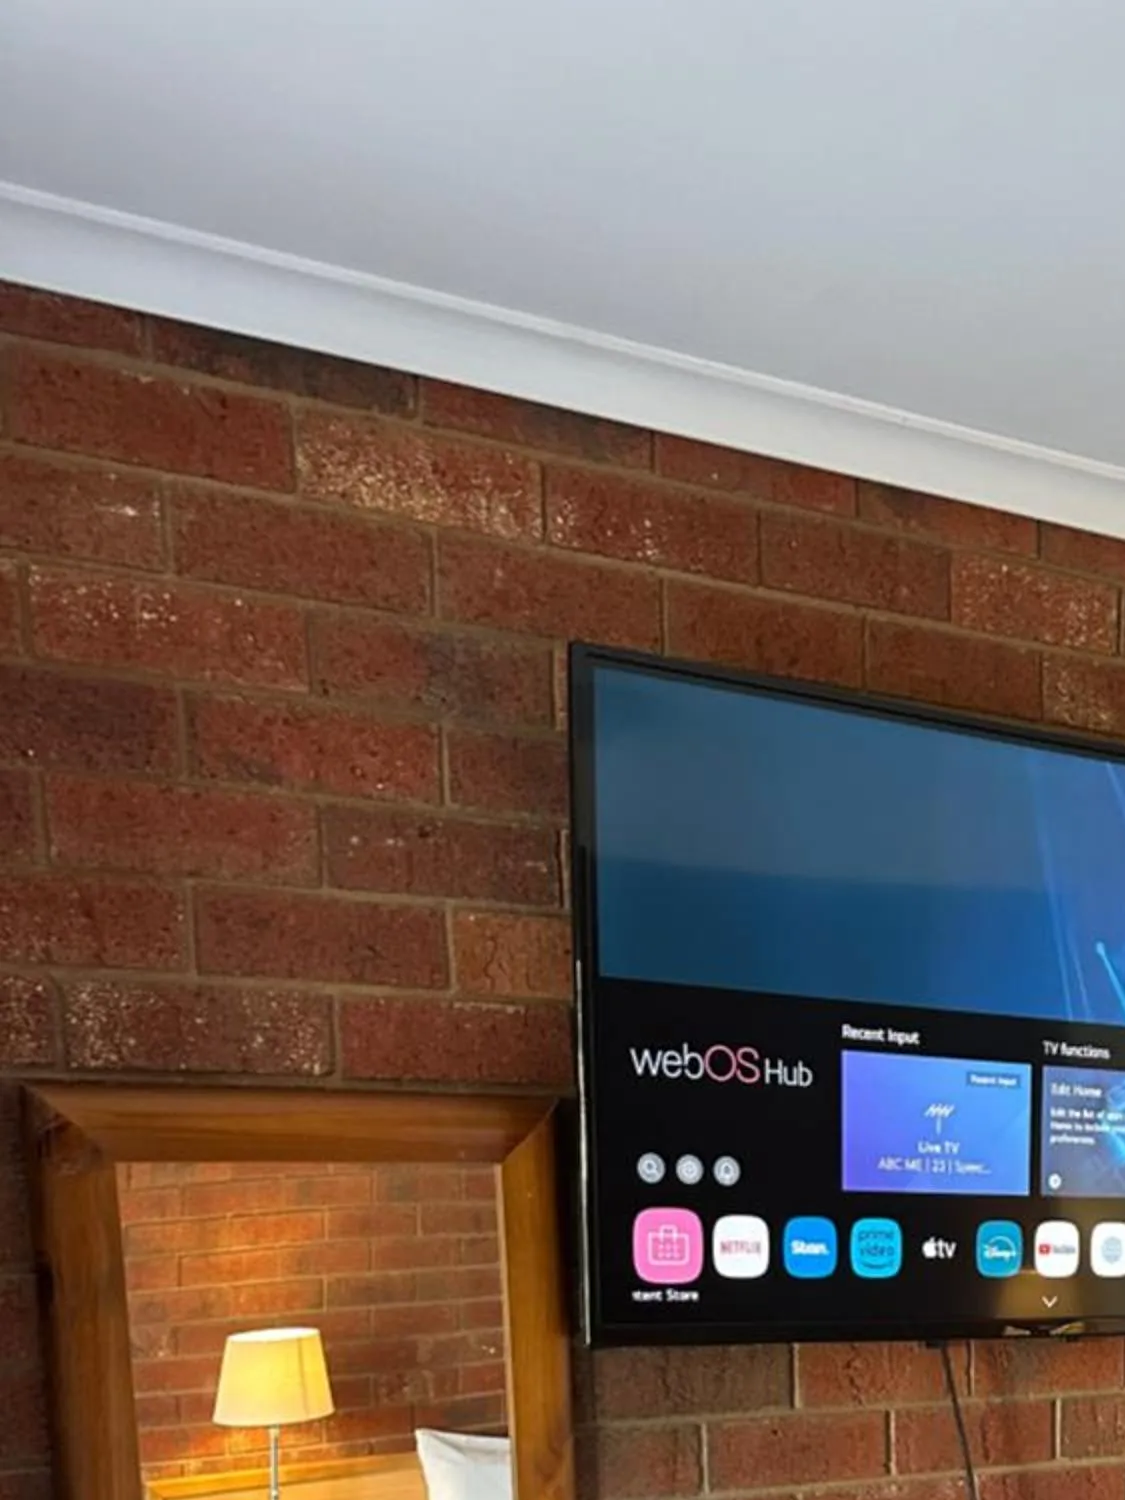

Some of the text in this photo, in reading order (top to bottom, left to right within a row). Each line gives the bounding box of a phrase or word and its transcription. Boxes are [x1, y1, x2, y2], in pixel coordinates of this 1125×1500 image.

[841, 1024, 920, 1046] Recent Input
[1043, 1041, 1110, 1059] TV functions
[629, 1043, 813, 1087] webOS Hub
[917, 1141, 960, 1154] Live TV
[878, 1157, 903, 1171] ABC
[937, 1239, 957, 1259] tv
[666, 1288, 699, 1303] Store
